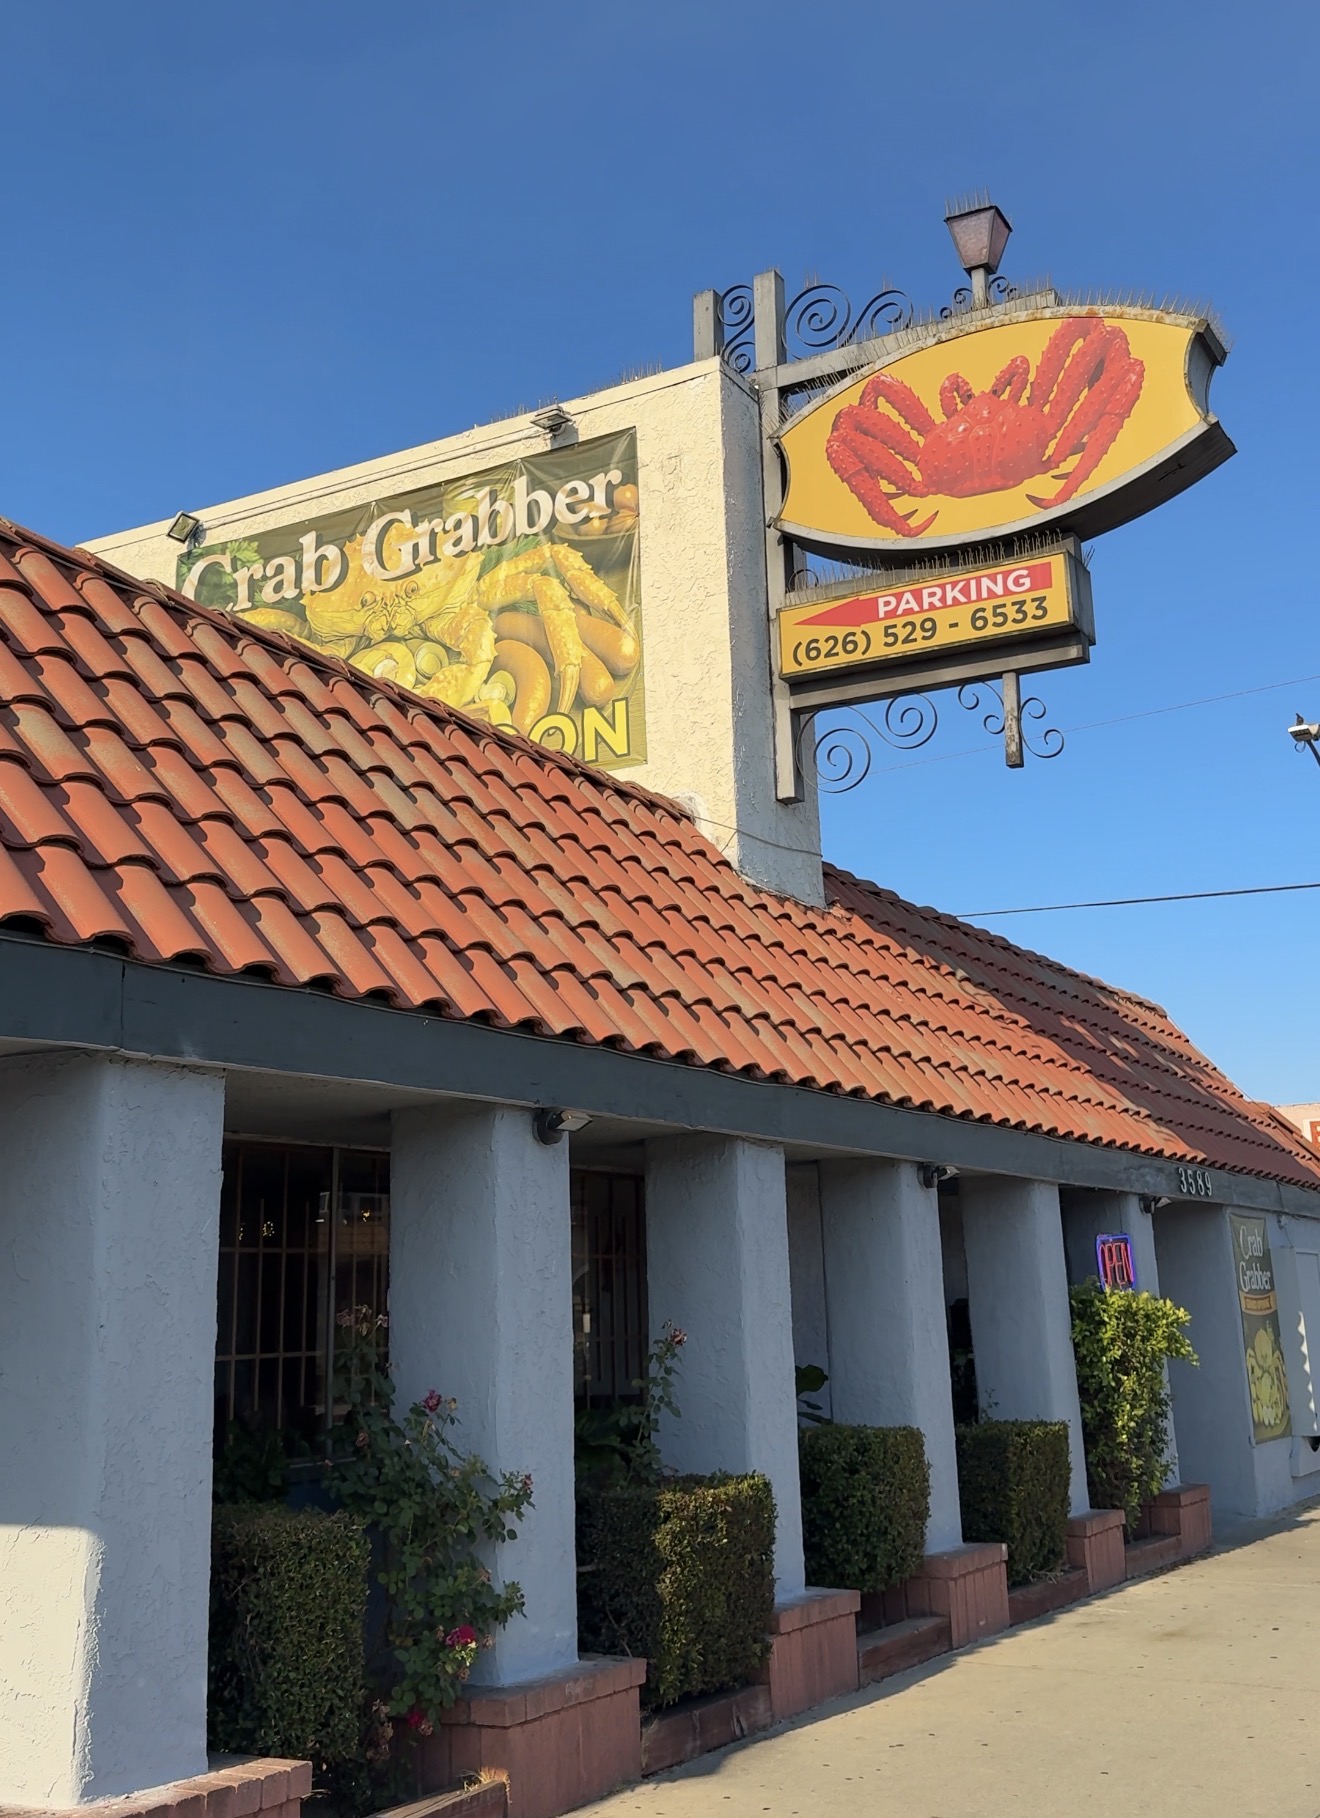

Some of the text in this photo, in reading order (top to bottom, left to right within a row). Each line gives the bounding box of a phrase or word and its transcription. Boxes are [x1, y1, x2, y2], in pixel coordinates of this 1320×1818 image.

[181, 469, 623, 612] Crab Grabber
[877, 569, 1032, 618] PARKING
[793, 630, 871, 666] (626)
[883, 617, 937, 647] 529
[970, 596, 1048, 631] 6533
[494, 697, 630, 763] ON
[1179, 1167, 1212, 1197] 3589
[1100, 1242, 1134, 1290] OPEN
[1240, 1225, 1264, 1260] Crab
[1240, 1261, 1271, 1292] Grabber
